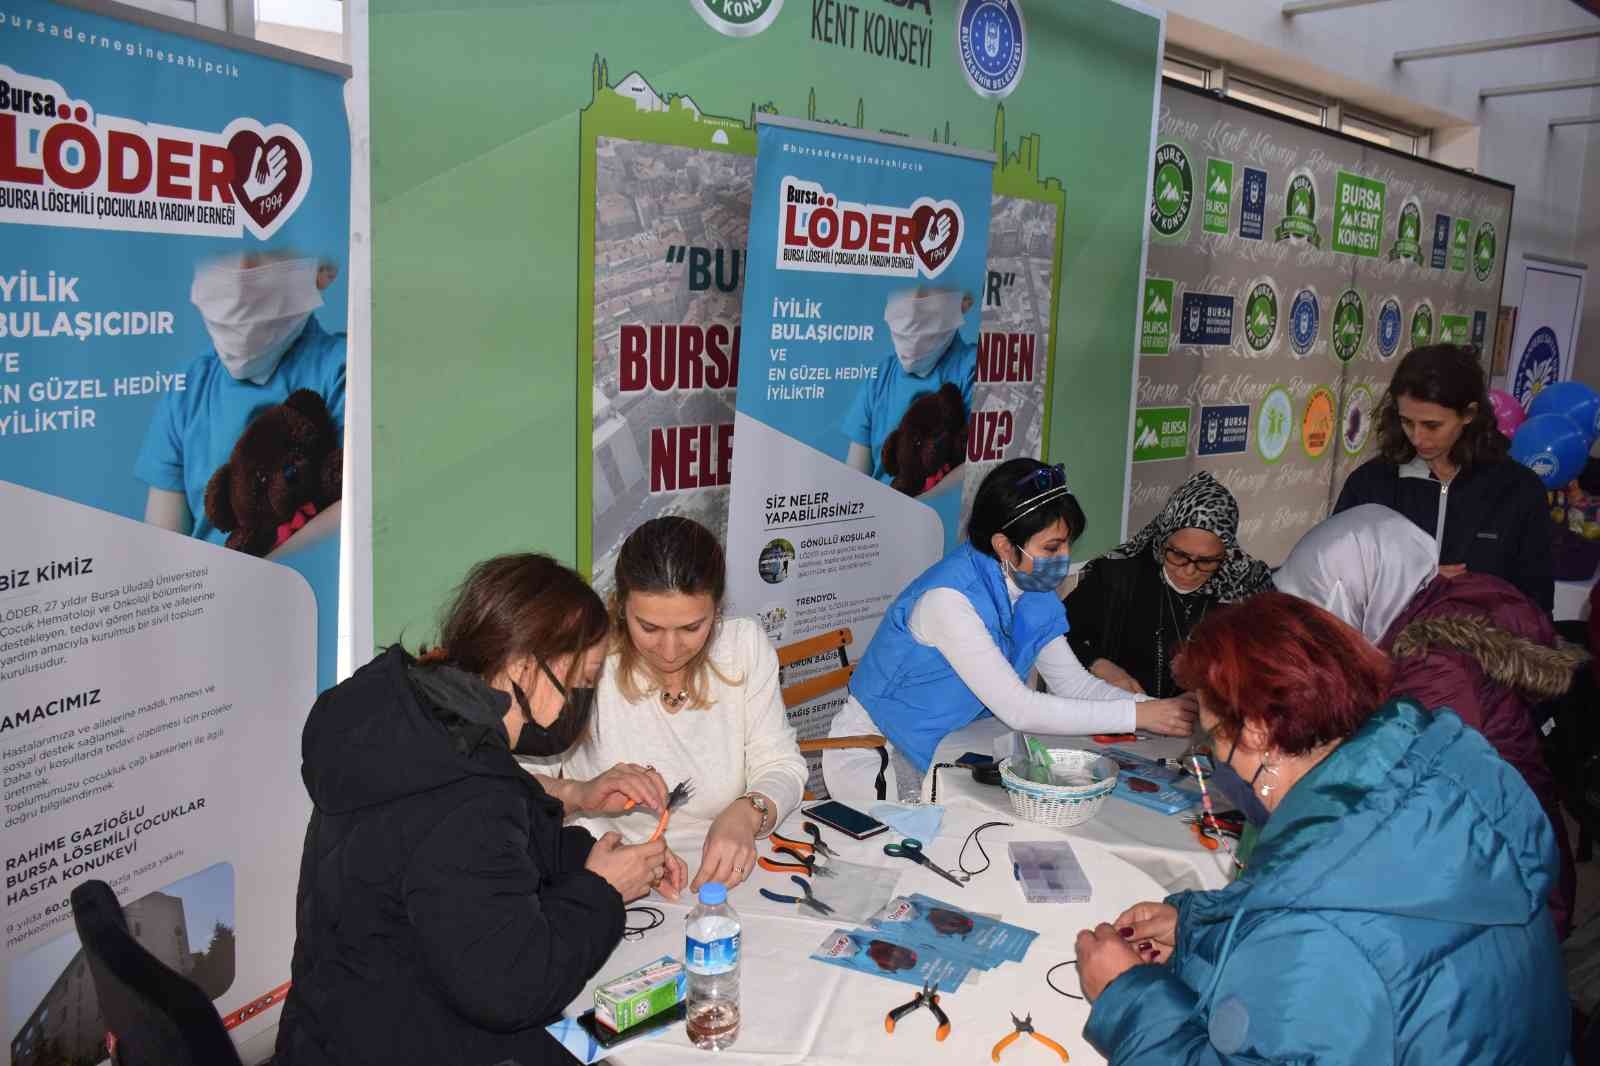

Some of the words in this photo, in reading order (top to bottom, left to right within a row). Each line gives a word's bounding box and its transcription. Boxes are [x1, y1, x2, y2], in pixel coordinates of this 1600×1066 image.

[811, 0, 860, 49] KENT
[863, 10, 933, 69] KONSEYİ
[0, 79, 57, 118] Bursa
[0, 103, 236, 204] LÖDER
[1156, 147, 1185, 170] BURSA
[259, 195, 283, 214] 1994
[786, 185, 818, 206] Bursa
[1341, 183, 1381, 211] BURSA
[42, 188, 95, 215] LÖSEMİLİ
[97, 195, 158, 219] ÇOCUKLARA
[160, 202, 195, 222] YARDIM
[197, 205, 236, 226] DERNEĞİ
[1205, 200, 1228, 214] BURSA
[784, 195, 917, 255] LÖDER
[1351, 210, 1380, 229] KENT
[1337, 227, 1378, 250] KONSEYİ
[783, 248, 804, 261] BURSA
[805, 249, 834, 264] LÖSEMİLİ
[834, 251, 869, 267] ÇOCUKLARA
[869, 254, 890, 268] YARDIM
[891, 256, 915, 270] DERNEĞİ
[772, 297, 822, 319] İYİLİK
[1207, 306, 1231, 318] BURSA
[771, 323, 874, 343] BULAŞICIDIR
[1143, 321, 1168, 334] BURSA
[0, 352, 20, 373] E
[770, 348, 787, 361] VE
[768, 368, 786, 381] EN
[790, 364, 832, 381] GÜZEL
[834, 363, 878, 380] HEDİYE
[0, 384, 20, 404] N
[29, 376, 107, 402] GÜZEL
[114, 370, 187, 397] HEDİYE
[767, 383, 825, 401] İYİLİKTİR
[1161, 420, 1187, 434] BURSA
[1224, 416, 1247, 427] BURSA
[765, 494, 786, 510] SİZ
[790, 491, 829, 507] NELER
[765, 501, 865, 526] YAPABİLİRSİNİZ?
[800, 535, 838, 549] GÖNÜLLÜ
[840, 530, 876, 544] KOŞULAR
[37, 556, 94, 583] KİMİZ
[91, 589, 120, 602] Bursa
[795, 592, 838, 607] TRENDYOL
[37, 607, 96, 627] Hematoloji
[70, 619, 103, 634] tedavi
[0, 648, 38, 669] yardım
[40, 636, 89, 656] amacıyla
[0, 688, 101, 733] AMACIMIZ
[6, 836, 65, 872] RAHİME
[71, 805, 145, 844] GAZİOĞLU
[6, 858, 59, 889] BURSA
[64, 828, 130, 864] LÖSEMİLİ
[134, 798, 206, 836] ÇOCUKLAR
[7, 875, 58, 907] HASTA
[62, 839, 138, 881] KONUKEVİ
